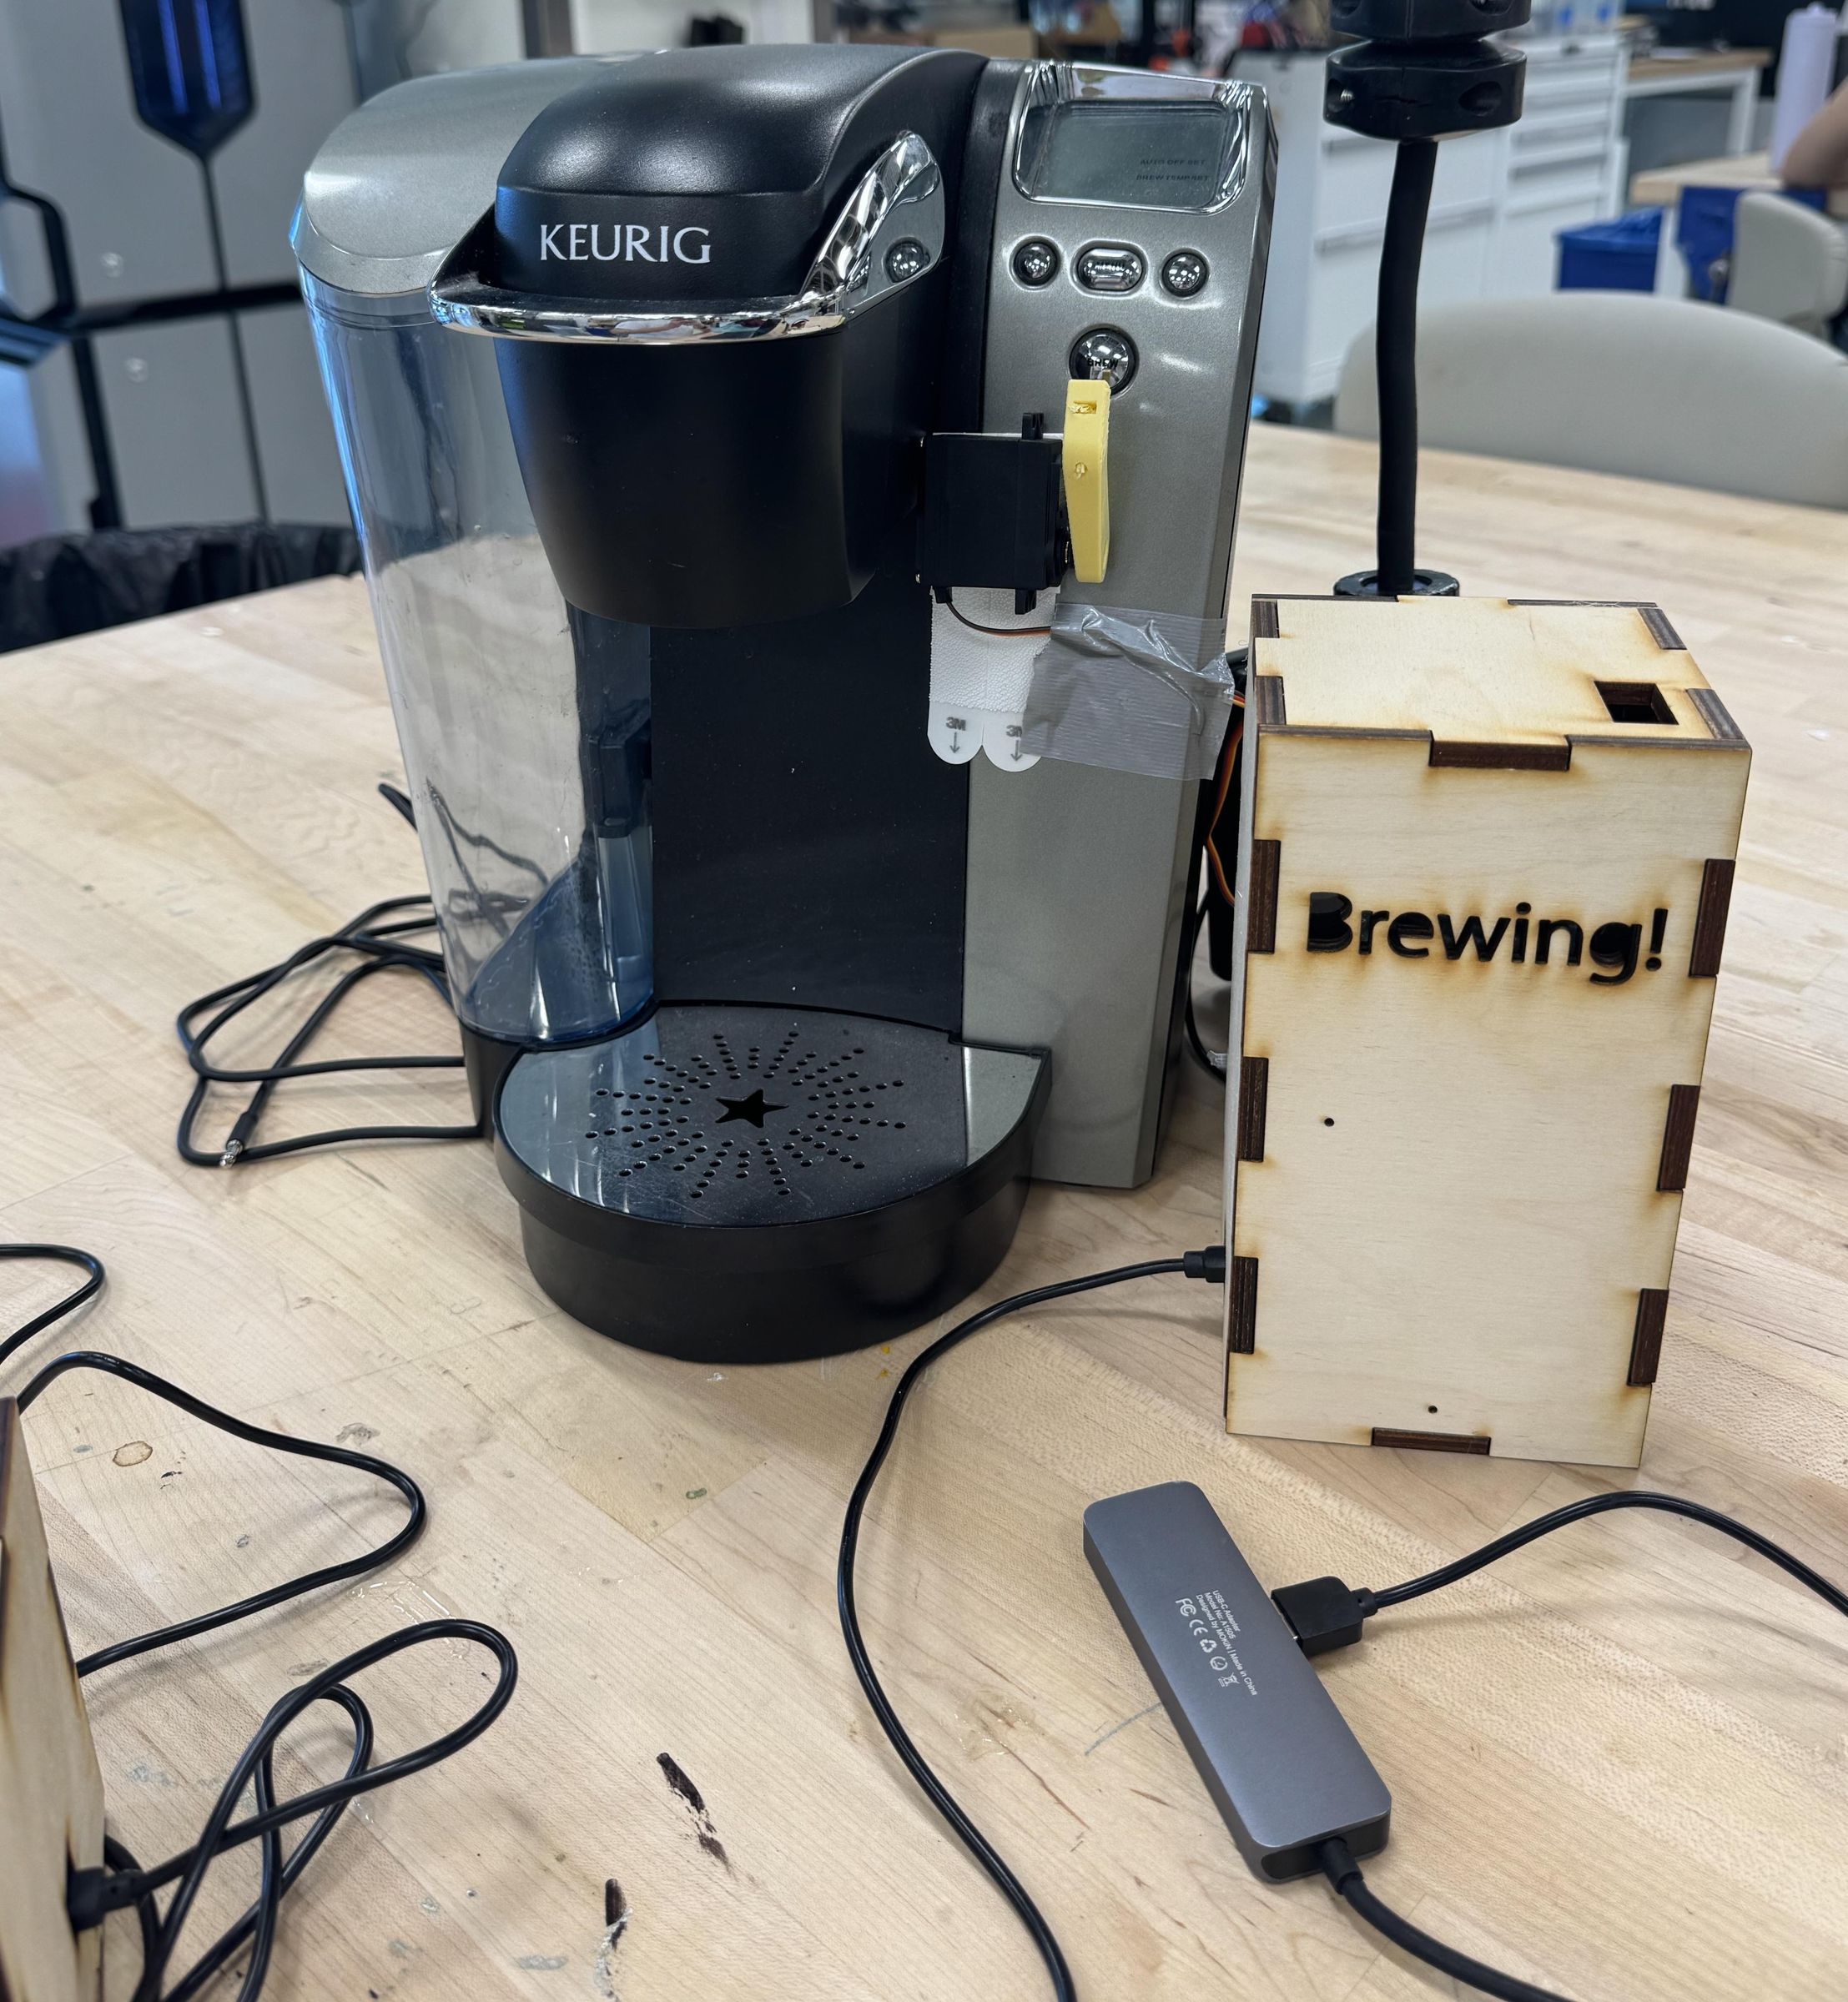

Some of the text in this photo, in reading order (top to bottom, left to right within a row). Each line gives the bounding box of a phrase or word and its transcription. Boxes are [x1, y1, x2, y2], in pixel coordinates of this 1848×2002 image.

[541, 224, 711, 264] KEURIG
[1087, 357, 1119, 368] BREW
[946, 717, 966, 731] 3M
[1307, 892, 1669, 985] Brewing!
[1205, 1592, 1218, 1609] Model
[1221, 1621, 1236, 1639] A1505
[1213, 1590, 1241, 1631] USB-C Adapter
[1196, 1595, 1216, 1620] Designed
[1230, 1653, 1242, 1670] Made
[1244, 1678, 1257, 1695] China
